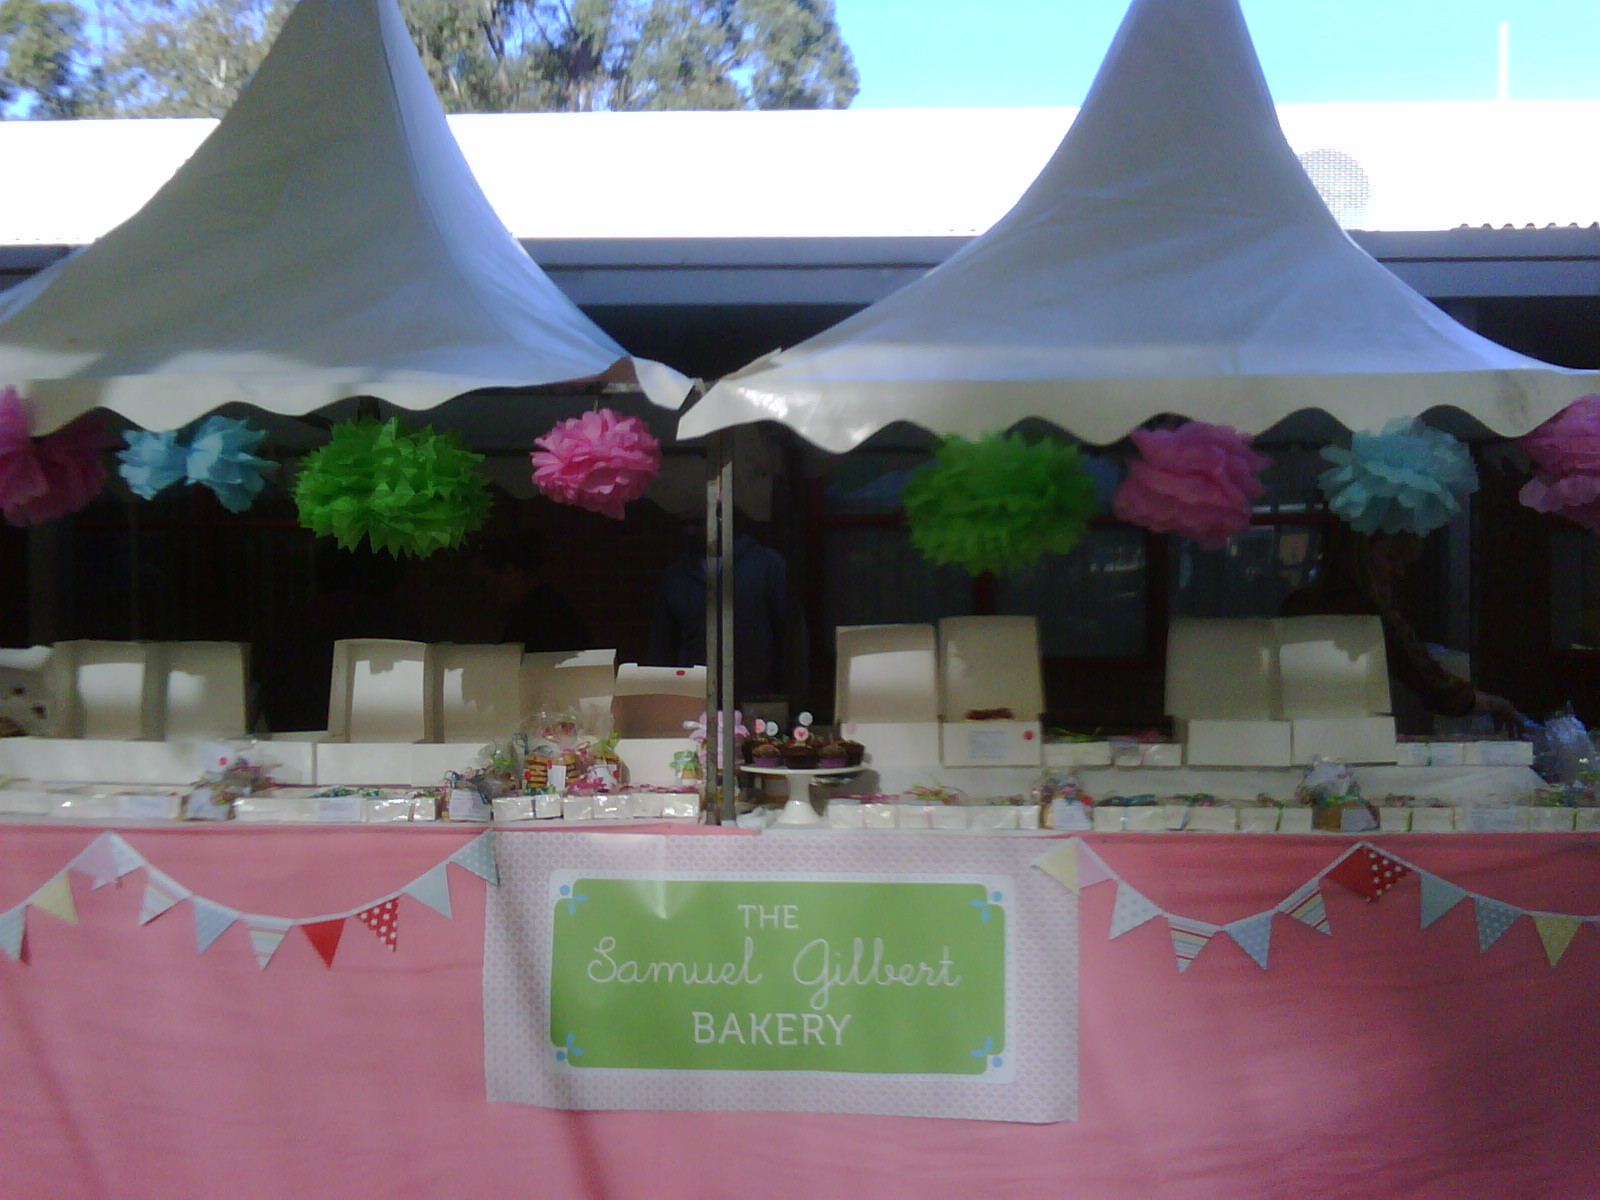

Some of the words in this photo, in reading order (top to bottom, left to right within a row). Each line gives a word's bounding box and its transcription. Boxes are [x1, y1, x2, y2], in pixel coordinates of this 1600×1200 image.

[738, 904, 799, 929] THE
[587, 936, 762, 985] Samuel
[793, 937, 962, 1011] Gilbert
[692, 1011, 853, 1046] BAKERY
